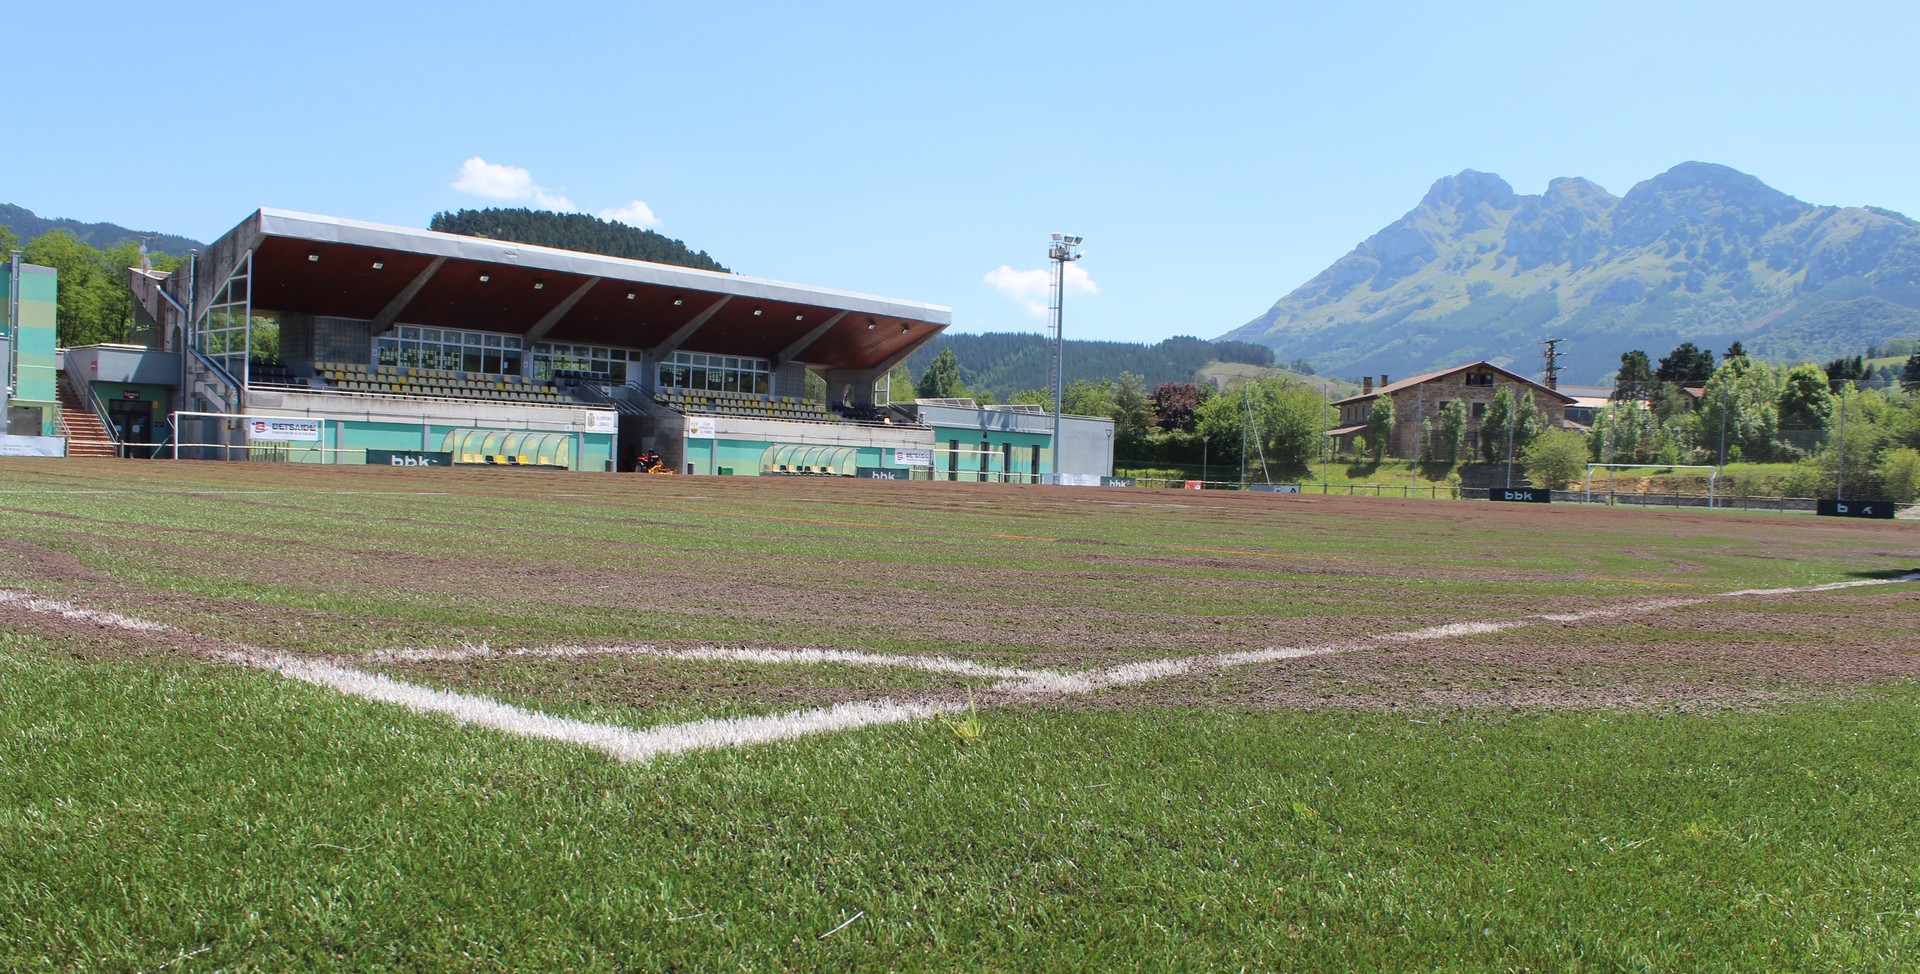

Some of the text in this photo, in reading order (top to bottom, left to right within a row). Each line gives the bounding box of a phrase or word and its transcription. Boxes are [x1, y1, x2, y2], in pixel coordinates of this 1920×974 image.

[391, 454, 430, 467] bbk
[1504, 491, 1533, 500] bbk
[1837, 503, 1873, 514] bk
